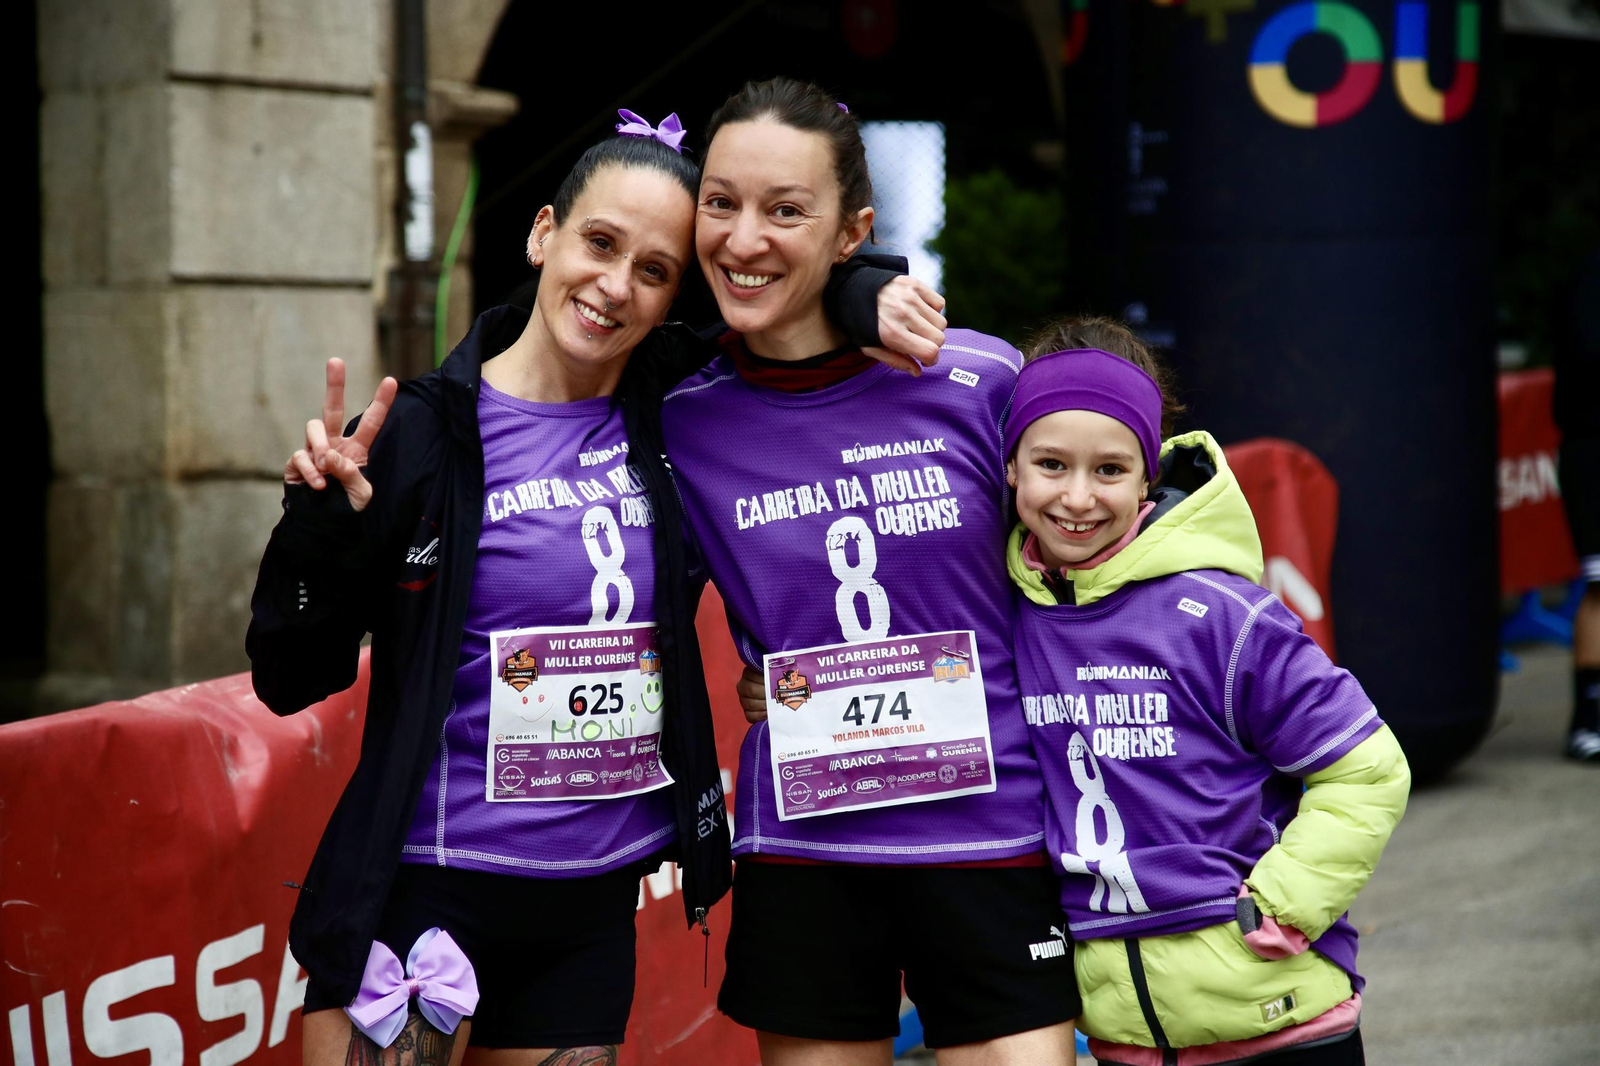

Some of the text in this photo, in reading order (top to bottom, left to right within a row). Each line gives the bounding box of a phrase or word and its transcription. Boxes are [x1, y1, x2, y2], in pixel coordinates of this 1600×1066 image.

[486, 478, 584, 522] CARREIRA
[576, 478, 614, 502] DA
[734, 466, 951, 530] CARREIRA DA MULLER
[875, 498, 963, 537] OURENSE
[549, 635, 634, 651] VII CARREIRA DA
[544, 652, 636, 668] MULLER OURENSE
[816, 643, 920, 668] VII CARREIRA DA
[815, 660, 926, 685] MULLER OURENSE
[568, 682, 624, 717] 625
[842, 691, 912, 726] 474
[1095, 693, 1168, 725] MULLER
[832, 723, 926, 743] YOLANDA MARCOS VILA
[1093, 727, 1177, 761] OURENSE
[941, 743, 967, 751] Concello
[942, 746, 983, 757] OURENSE
[569, 773, 595, 783] ABRIL
[856, 779, 882, 791] ABRIL
[786, 788, 812, 798] NISSAN
[1029, 939, 1066, 961] PUMA
